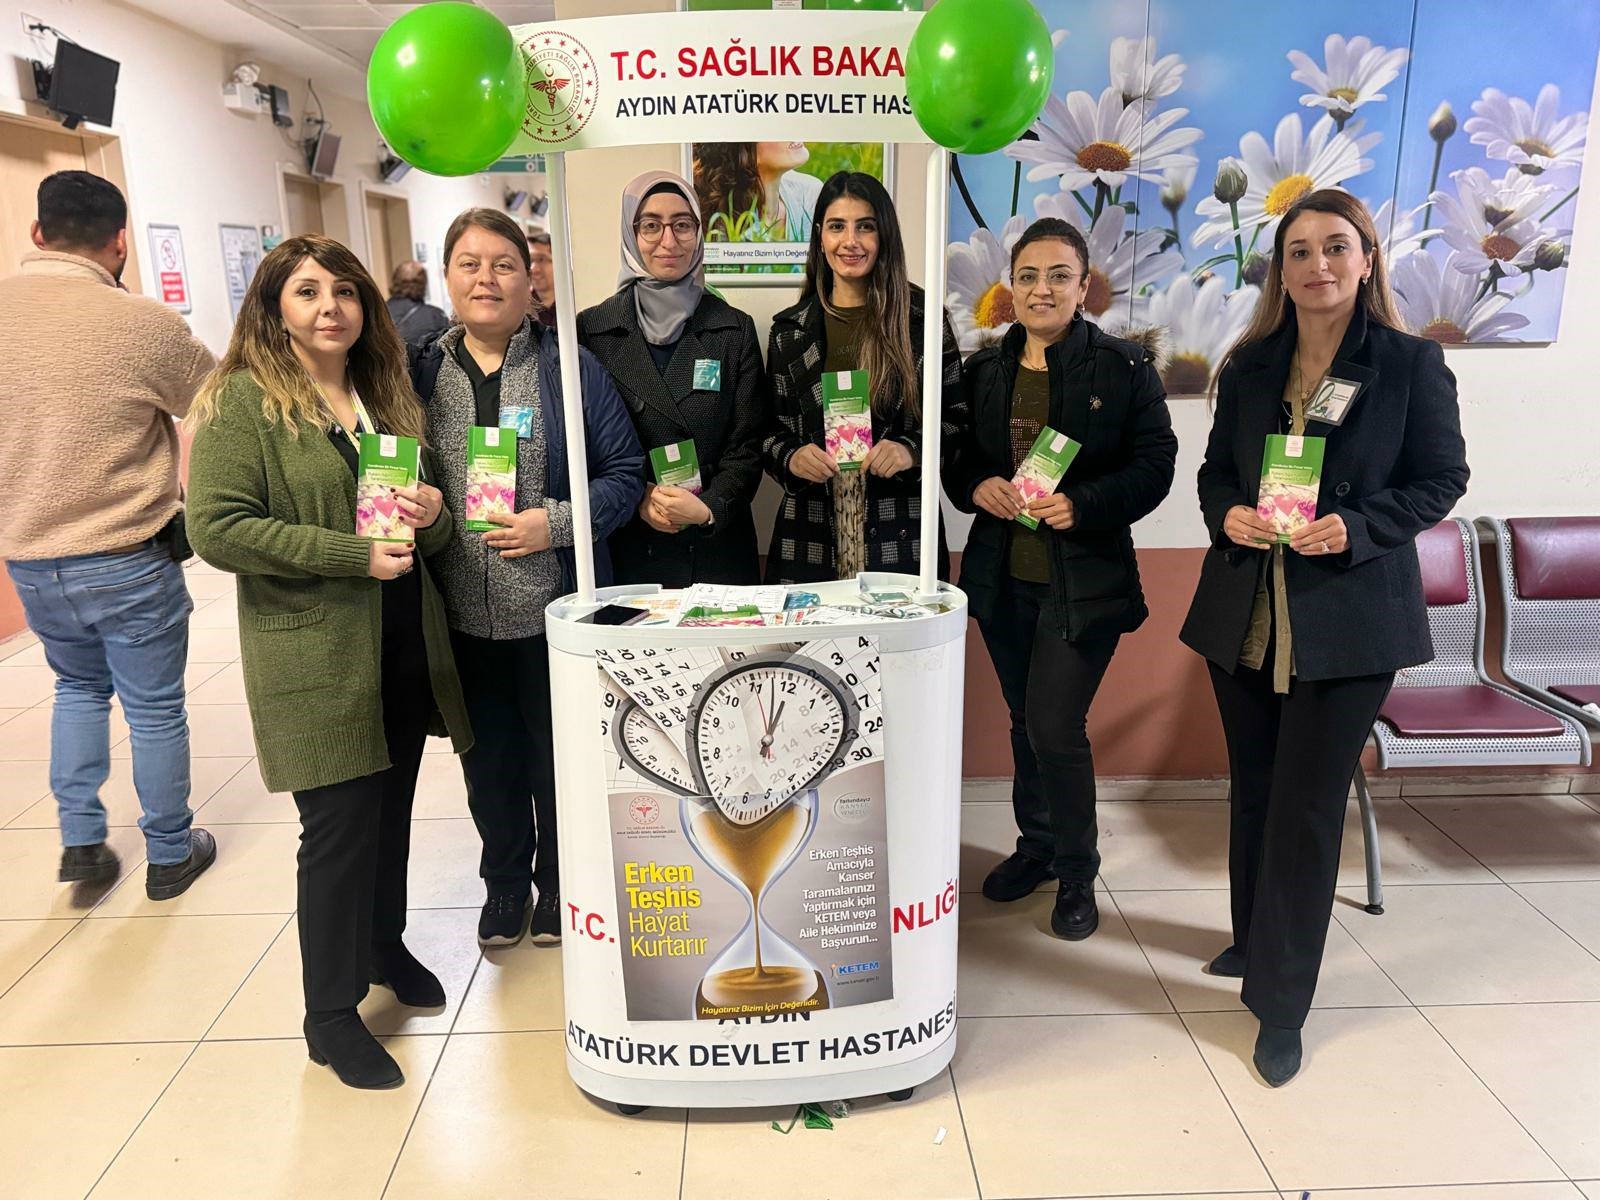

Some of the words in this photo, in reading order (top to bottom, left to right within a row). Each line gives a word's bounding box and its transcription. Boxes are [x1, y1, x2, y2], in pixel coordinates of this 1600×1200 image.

[610, 49, 666, 81] T.C.
[677, 38, 802, 78] SAĞLIK
[813, 45, 906, 77] BAKA
[616, 95, 676, 118] AYDIN
[682, 89, 779, 115] ATATÜRK
[785, 93, 867, 114] DEVLET
[858, 636, 869, 648] 4
[678, 662, 690, 670] 7
[831, 652, 844, 665] 3
[634, 667, 653, 681] 21
[655, 661, 671, 677] 14
[613, 670, 634, 686] 28
[652, 685, 670, 701] 22
[672, 681, 687, 697] 15
[749, 681, 763, 694] 11
[780, 681, 797, 694] 12
[634, 690, 654, 707] 29
[725, 695, 740, 708] 10
[809, 698, 816, 710] 1
[655, 711, 672, 728] 30
[670, 706, 687, 723] 23
[712, 717, 720, 728] 9
[819, 722, 830, 735] 2
[713, 747, 720, 759] 8
[809, 751, 819, 762] 3
[851, 746, 873, 761] 30
[724, 776, 731, 788] 7
[787, 773, 797, 783] 4
[742, 791, 749, 804] 6
[764, 788, 772, 799] 5
[809, 849, 840, 861] Erken
[841, 844, 874, 858] Teşhis
[826, 858, 874, 872] Amacıyla
[624, 861, 693, 885] Erken
[838, 870, 875, 883] Kanser
[625, 885, 701, 913] Teşhis
[802, 884, 875, 900] Taramalarınızı
[802, 897, 855, 913] Yaptırmak
[857, 895, 876, 907] için
[567, 902, 615, 944] T.C.
[628, 911, 690, 937] Hayat
[814, 911, 850, 924] KETEM
[852, 909, 876, 920] veya
[799, 926, 819, 939] Aile
[821, 920, 877, 936] Hekiminize
[630, 935, 708, 957] Kurtarır
[821, 933, 878, 949] Başvurun...
[838, 961, 880, 975] KETEM
[701, 1006, 740, 1015] Hayatınız
[741, 1004, 764, 1013] Bizim
[764, 1002, 779, 1012] İçin
[568, 1019, 680, 1066] ATATÜRK
[690, 1040, 809, 1067] DEVLET
[820, 989, 956, 1060] HASTANESİ
